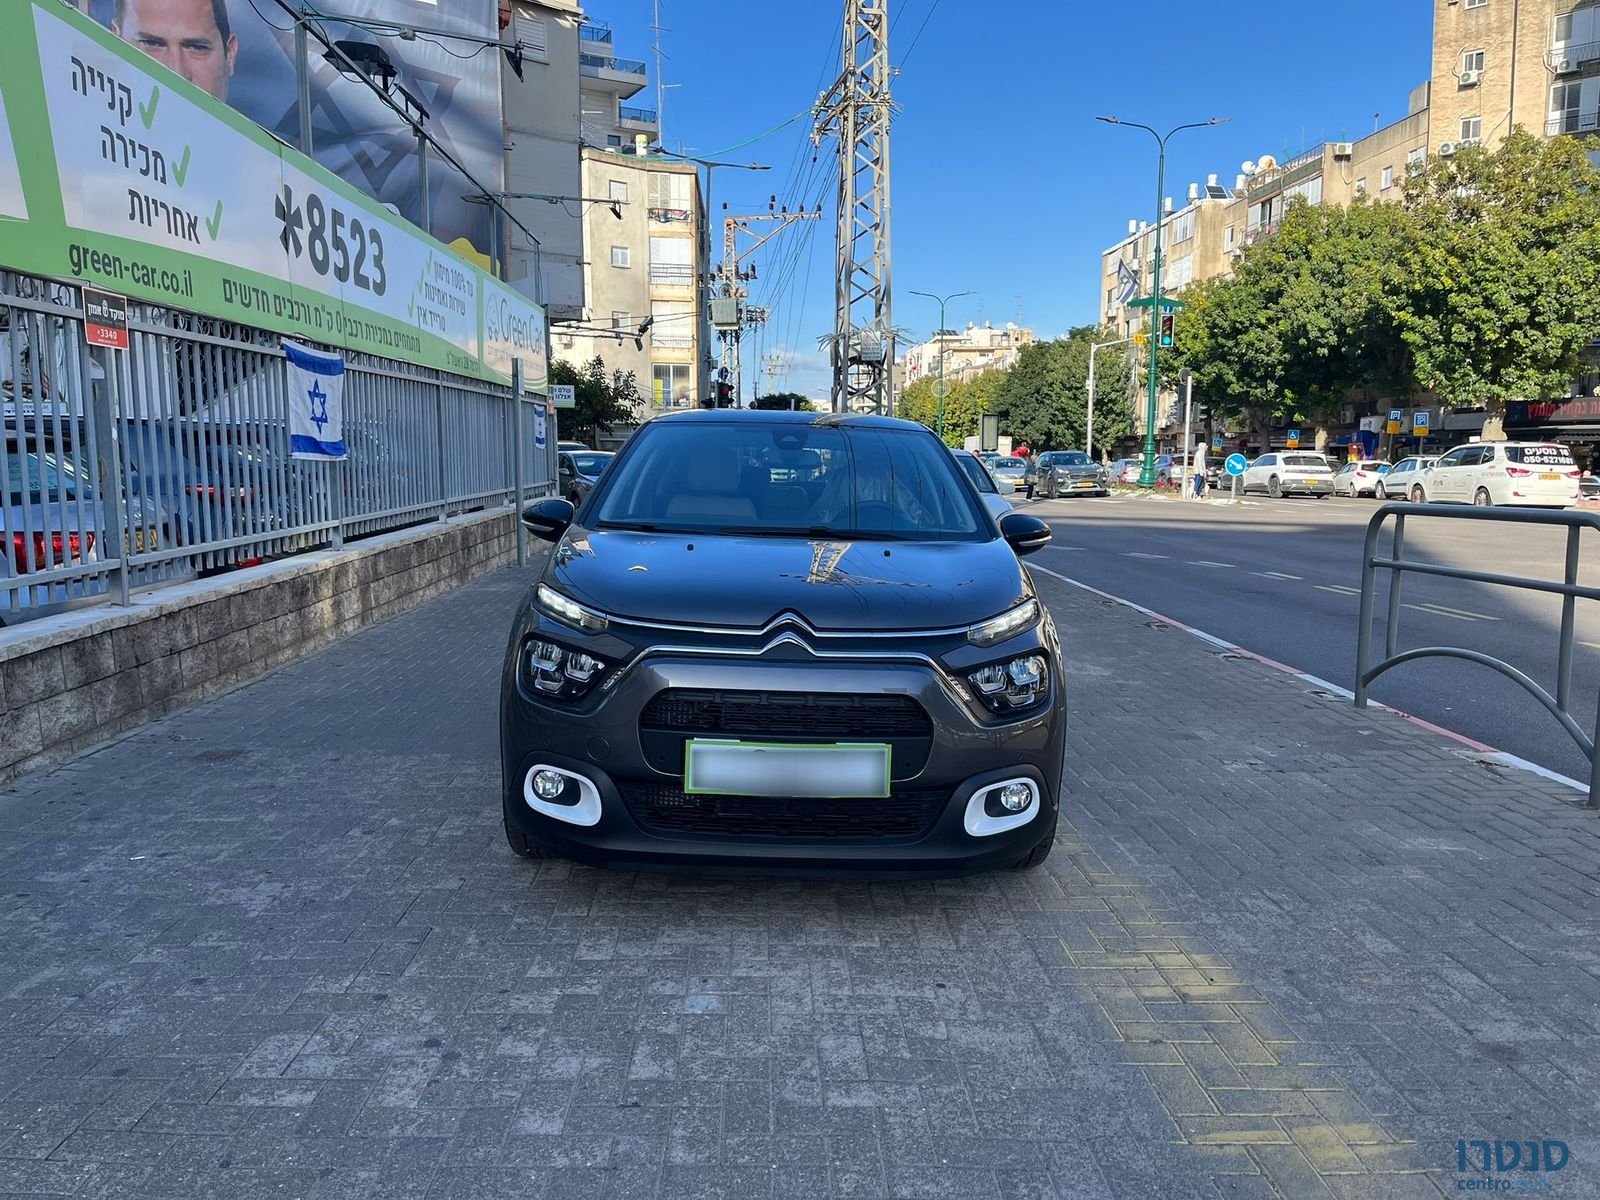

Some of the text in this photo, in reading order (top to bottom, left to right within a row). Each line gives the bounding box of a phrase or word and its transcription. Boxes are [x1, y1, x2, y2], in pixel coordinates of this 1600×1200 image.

[71, 55, 133, 126] קנייה
[100, 126, 167, 185] מכירה
[128, 189, 201, 244] אחריות
[69, 243, 194, 297] green-car.co.il
[433, 260, 450, 285] מימון
[109, 308, 125, 321] מוקד
[222, 277, 421, 353] מתמחים במכירת רכבי 0 ק"מ ורכבים חדשים
[416, 305, 446, 332] טרייד אין
[449, 295, 466, 316] שירות
[500, 297, 543, 355] Green Car
[1524, 447, 1558, 456] נוסעים
